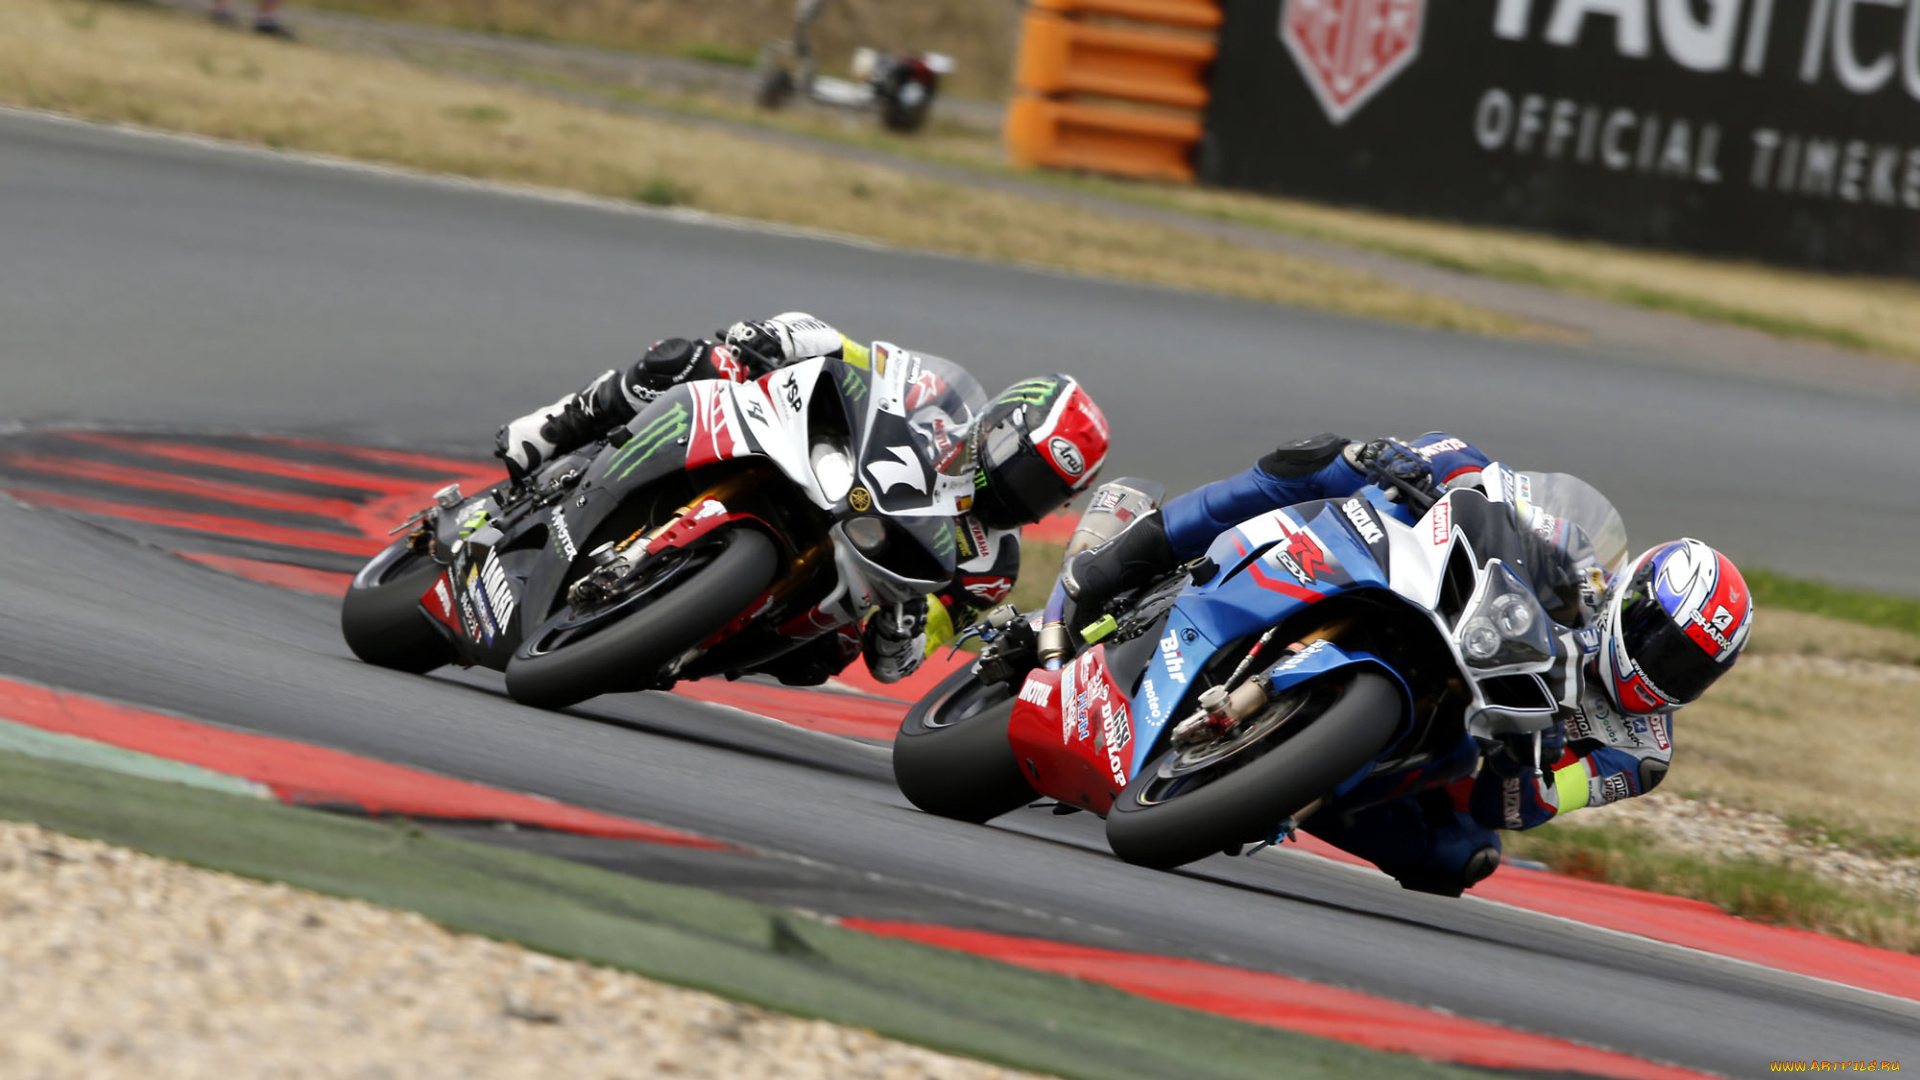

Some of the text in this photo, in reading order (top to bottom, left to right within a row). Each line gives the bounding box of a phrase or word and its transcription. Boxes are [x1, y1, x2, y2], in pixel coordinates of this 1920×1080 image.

[1476, 88, 1722, 183] OFFICIAL
[784, 371, 801, 412] YSP
[867, 445, 928, 496] 7
[1053, 439, 1084, 474] Arai
[551, 505, 577, 562] MONSTER
[971, 525, 990, 558] YAMAHA
[1342, 498, 1384, 545] SUZUKI
[1434, 503, 1448, 544] MOTUL
[1277, 551, 1311, 586] GSX
[481, 545, 515, 636] YAMAHA
[1689, 608, 1734, 652] SHARK
[1160, 629, 1187, 685] Bihr
[1018, 677, 1053, 708] MOTUL
[1143, 679, 1162, 718] moteo
[1101, 700, 1128, 787] DUNLOP
[1622, 716, 1644, 747] HARK
[1650, 713, 1668, 749] OTUL
[1502, 777, 1524, 829] SUZUKI
